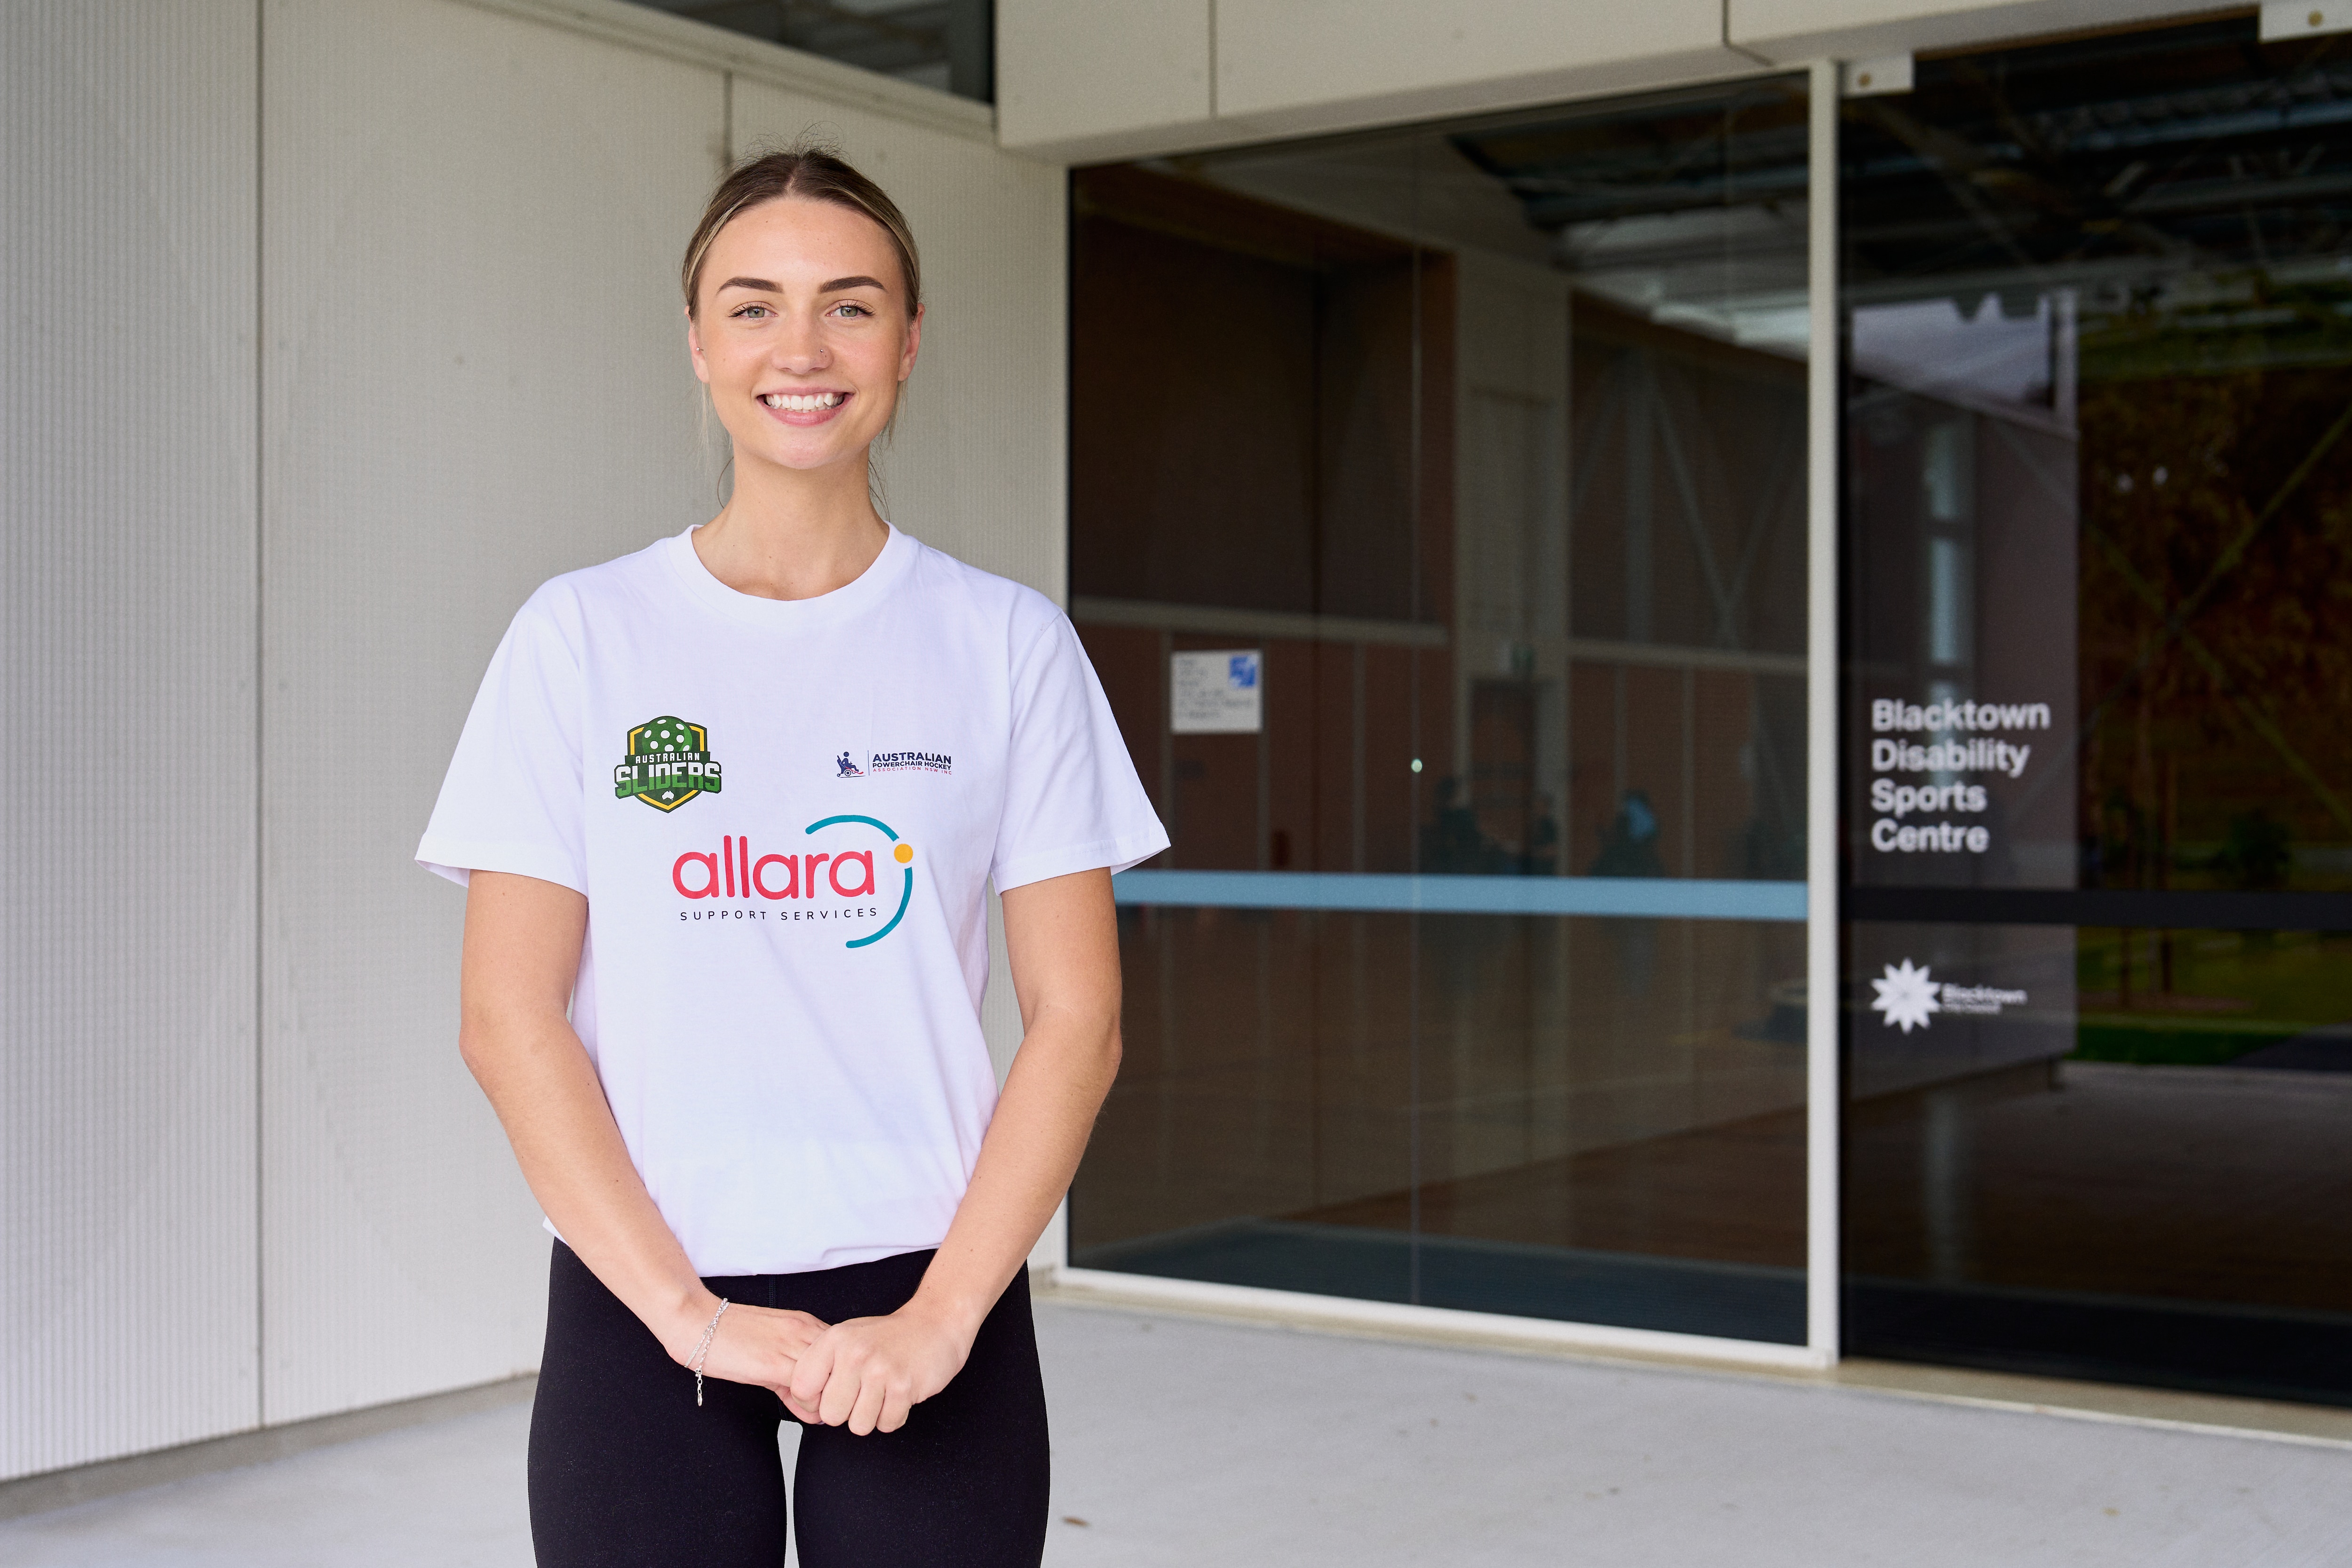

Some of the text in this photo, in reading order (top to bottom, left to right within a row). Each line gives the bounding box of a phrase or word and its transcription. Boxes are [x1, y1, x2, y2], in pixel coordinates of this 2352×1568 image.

[1872, 698, 2051, 732] Blacktown
[635, 752, 700, 764] AUSTRALIAN
[873, 752, 951, 764] AUSTRALIAN
[924, 762, 951, 770] HOCKEY
[1871, 738, 2031, 778] Disability
[616, 762, 720, 797] SLIDERS
[1871, 778, 1987, 819] Sports
[1871, 818, 1990, 853] Centre
[673, 835, 875, 900] allara
[680, 907, 877, 921] SUPPORT SERVICES
